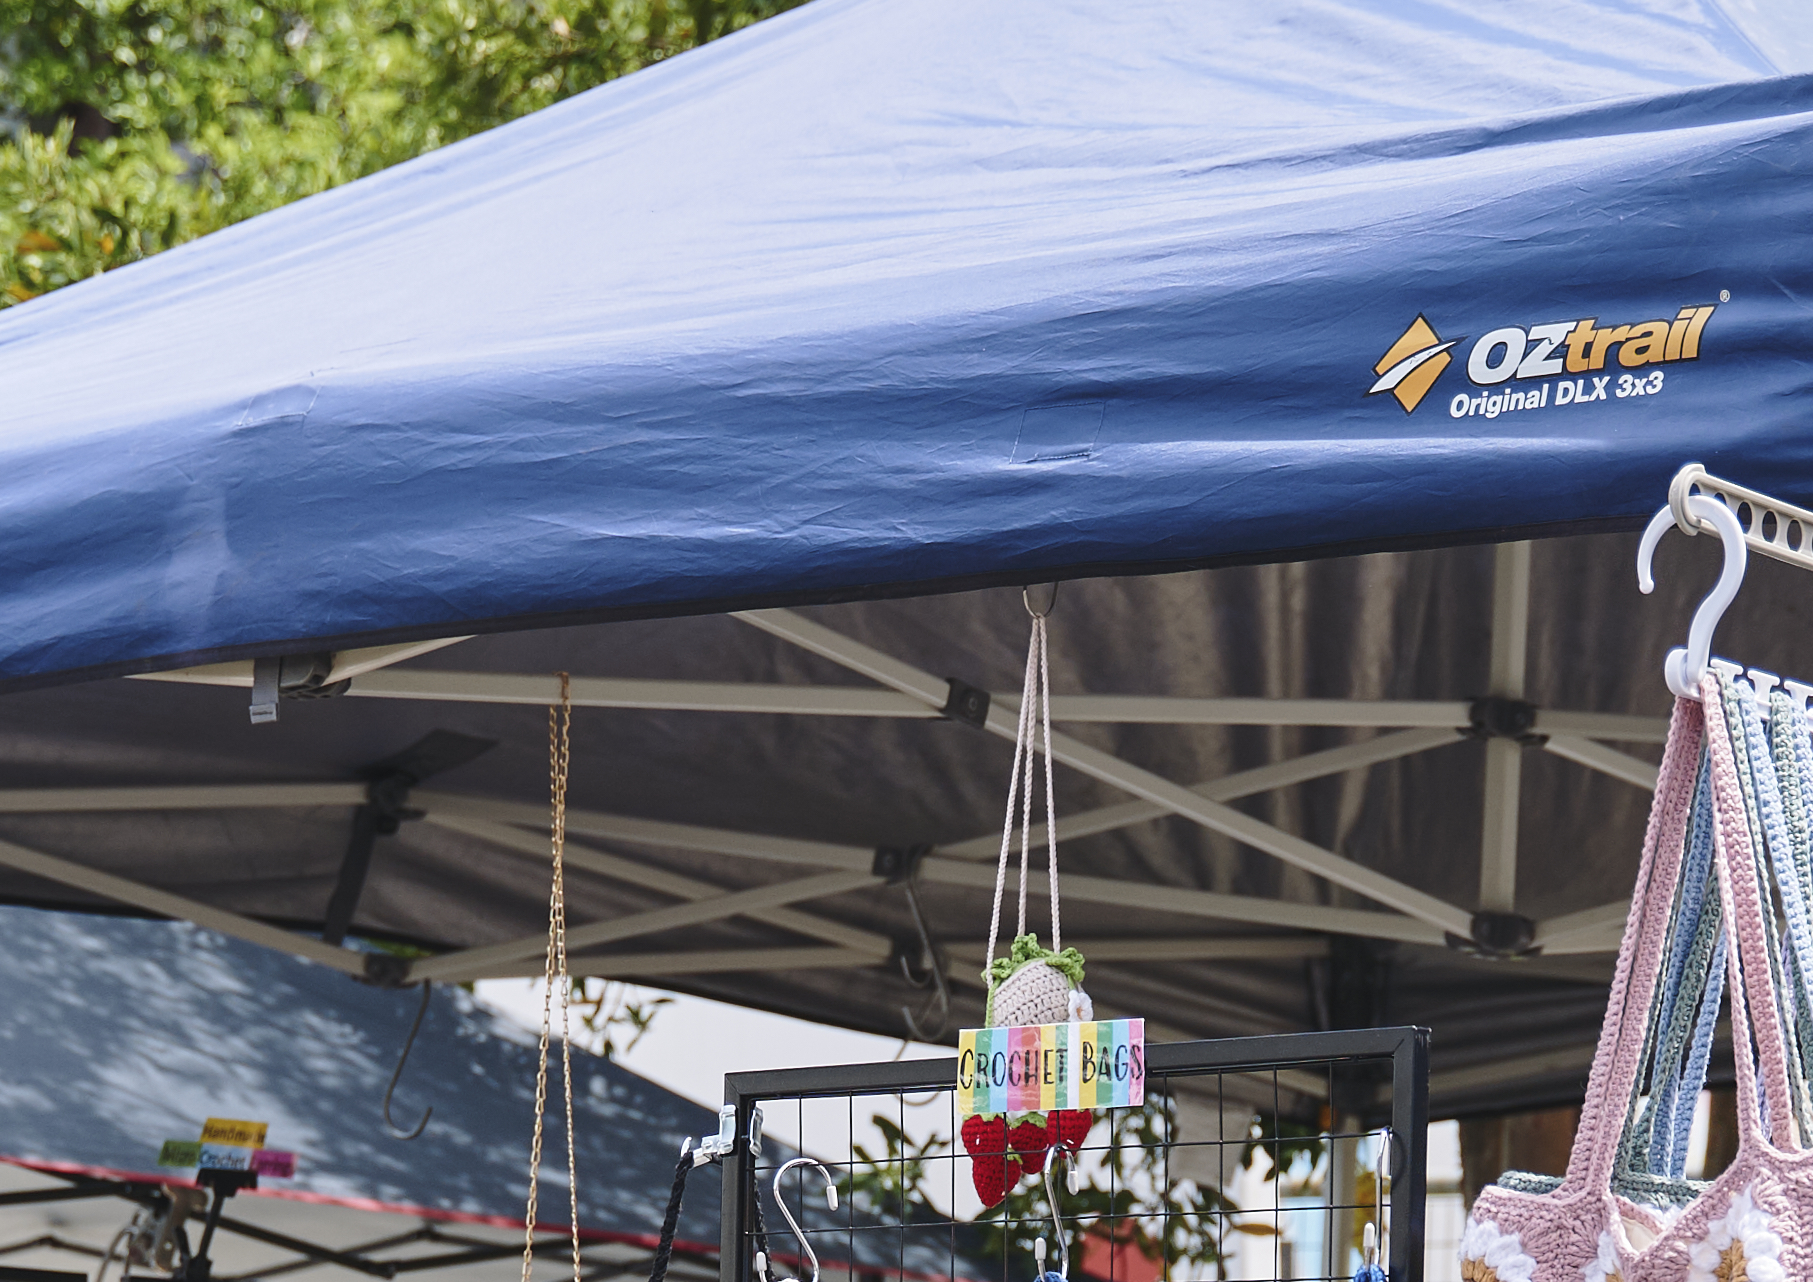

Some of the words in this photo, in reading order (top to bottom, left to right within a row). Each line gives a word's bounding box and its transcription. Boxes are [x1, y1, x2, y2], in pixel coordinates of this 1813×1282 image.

[1449, 382, 1547, 418] Original
[1554, 377, 1607, 407] DLX
[1614, 370, 1665, 398] 3x3
[959, 1047, 1068, 1090] CROCHET
[1082, 1041, 1144, 1084] BAGS
